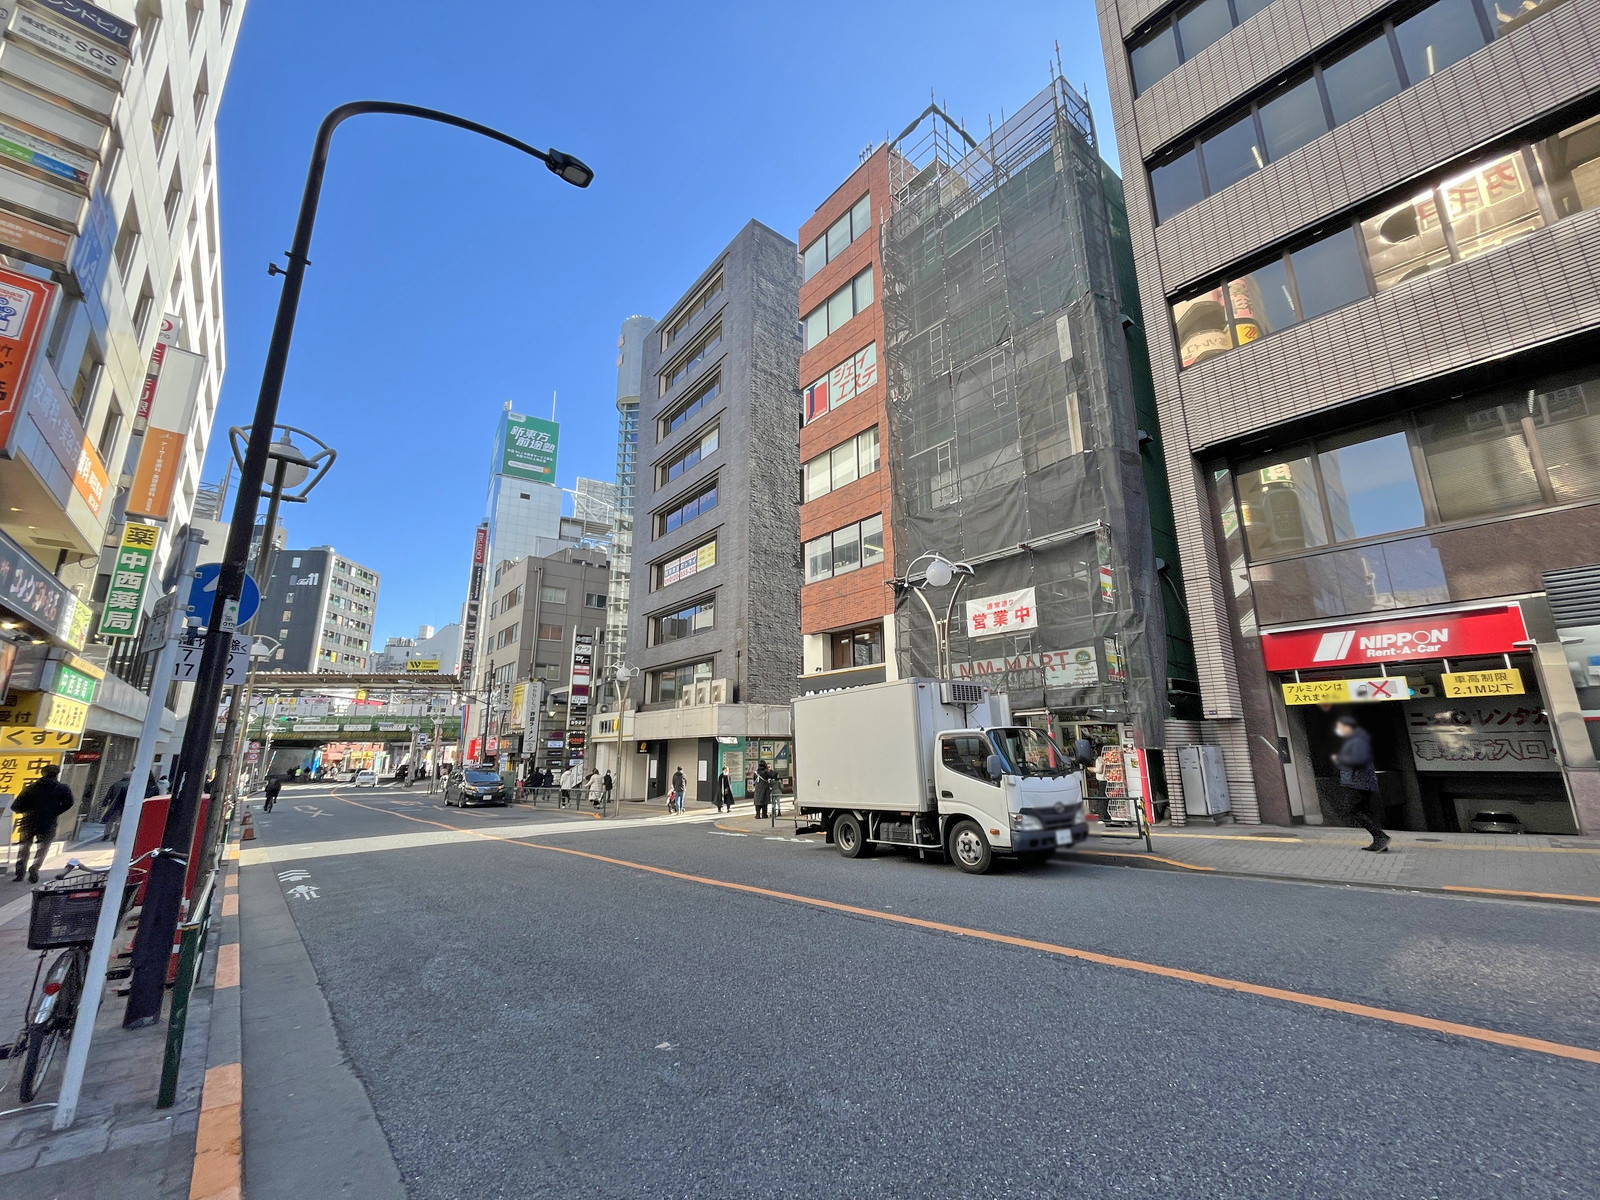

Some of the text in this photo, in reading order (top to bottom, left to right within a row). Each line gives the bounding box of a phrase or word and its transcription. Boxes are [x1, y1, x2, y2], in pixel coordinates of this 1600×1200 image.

[75, 40, 118, 67] SGS
[832, 348, 870, 387] ジェイ
[835, 363, 876, 403] エステ
[510, 426, 551, 441] 新東方
[126, 527, 155, 546] 薬
[104, 552, 148, 630] 中西薬局
[986, 599, 1014, 610] 通常通り
[972, 605, 1031, 631] 営業中
[1359, 628, 1449, 650] NIPPON
[1366, 644, 1441, 658] Rent-A-Car
[174, 663, 195, 676] 17
[1454, 672, 1508, 684] 車高制限
[1287, 683, 1343, 694] アルミバンは
[1453, 683, 1514, 695] 2.1M以下
[6, 729, 74, 746] くすり
